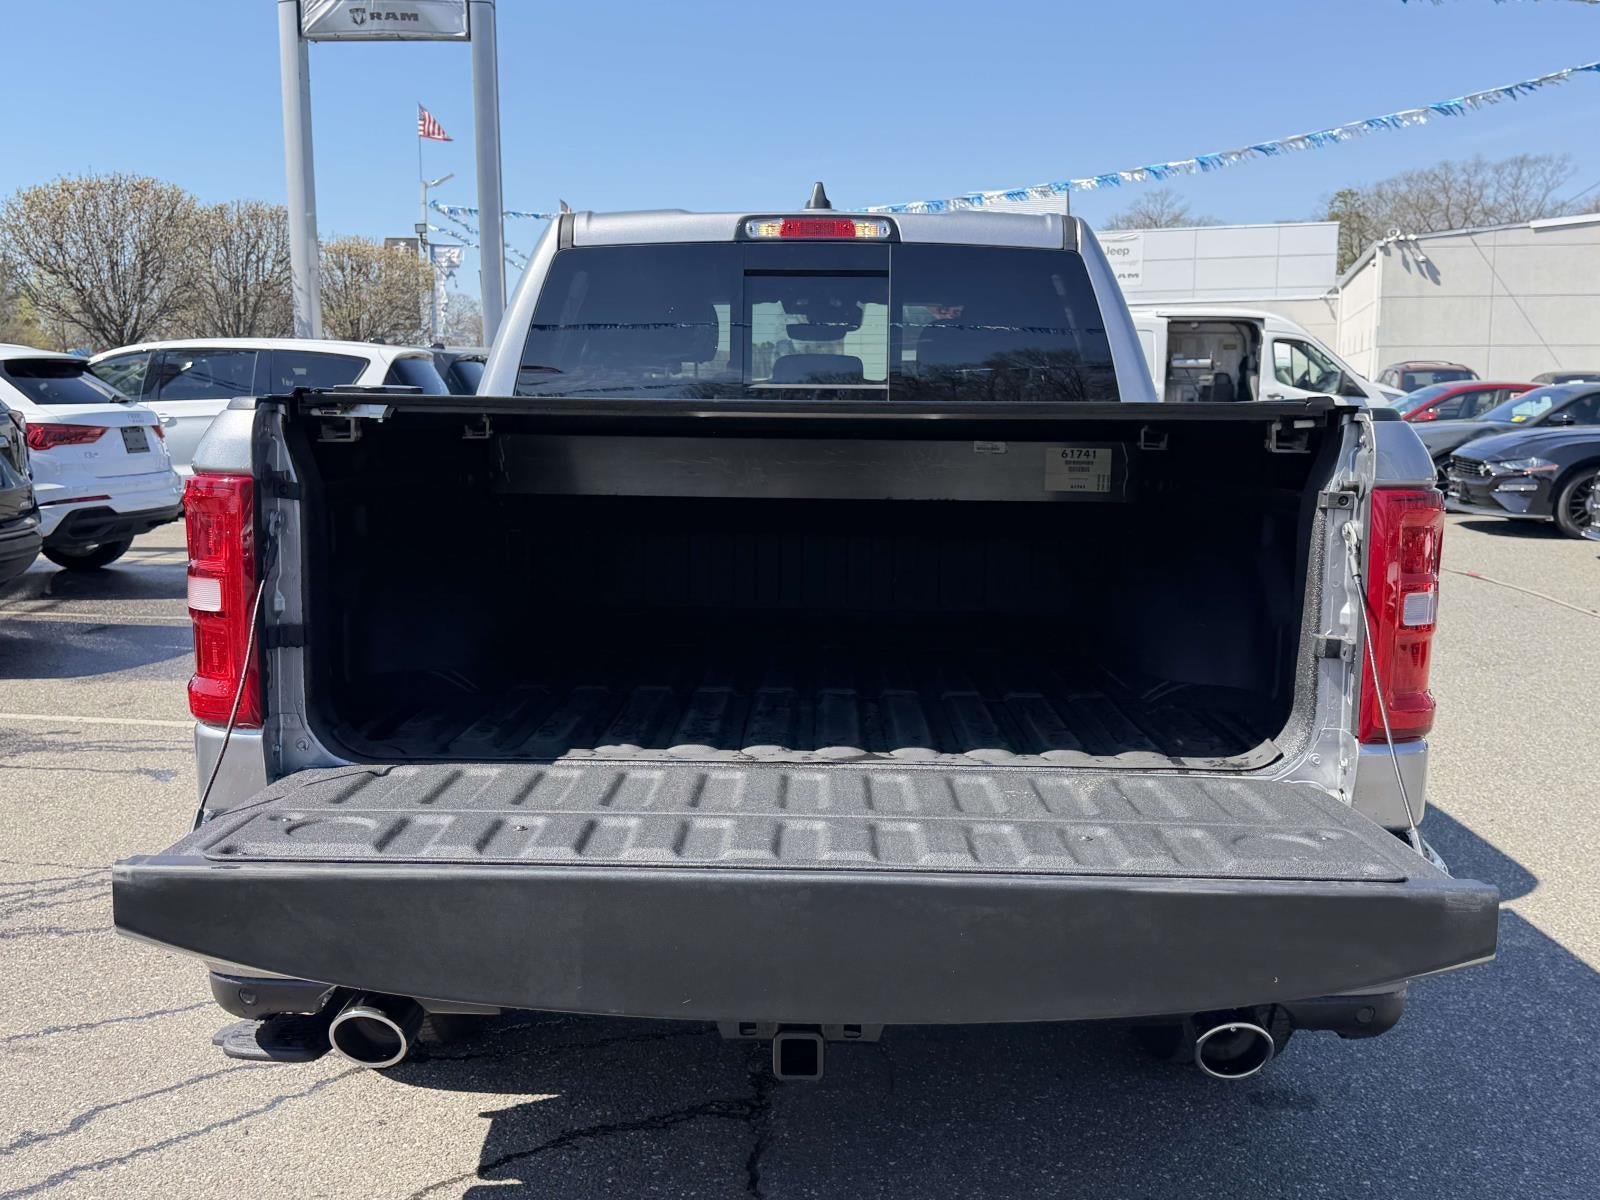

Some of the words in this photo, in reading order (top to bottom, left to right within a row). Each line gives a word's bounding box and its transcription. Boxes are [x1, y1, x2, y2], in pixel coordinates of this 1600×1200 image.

[369, 12, 419, 21] RAM
[1104, 246, 1130, 257] Jeep
[1061, 449, 1097, 459] 61741
